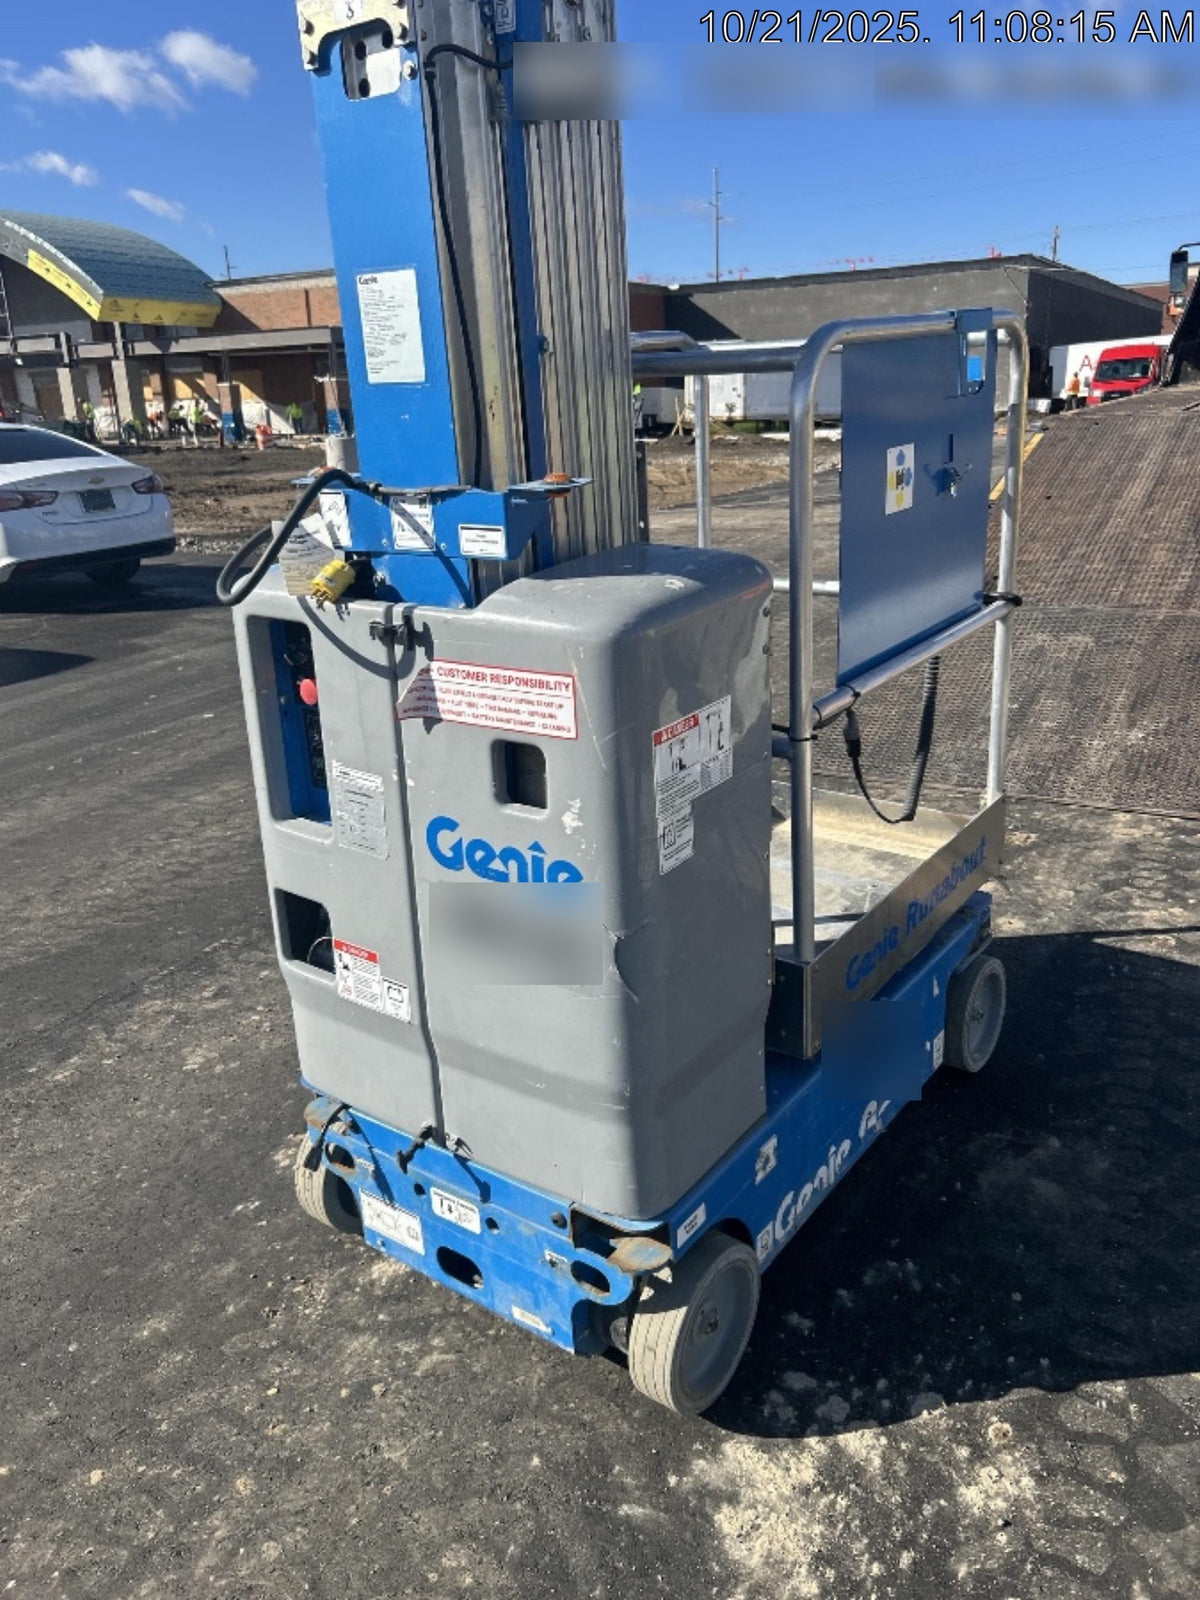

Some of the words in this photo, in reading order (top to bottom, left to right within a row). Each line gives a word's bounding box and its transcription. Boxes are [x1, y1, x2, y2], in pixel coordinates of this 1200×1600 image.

[437, 665, 488, 683] CUSTOMER
[490, 673, 571, 692] RESPONSIBILITY
[845, 925, 900, 992] Genie
